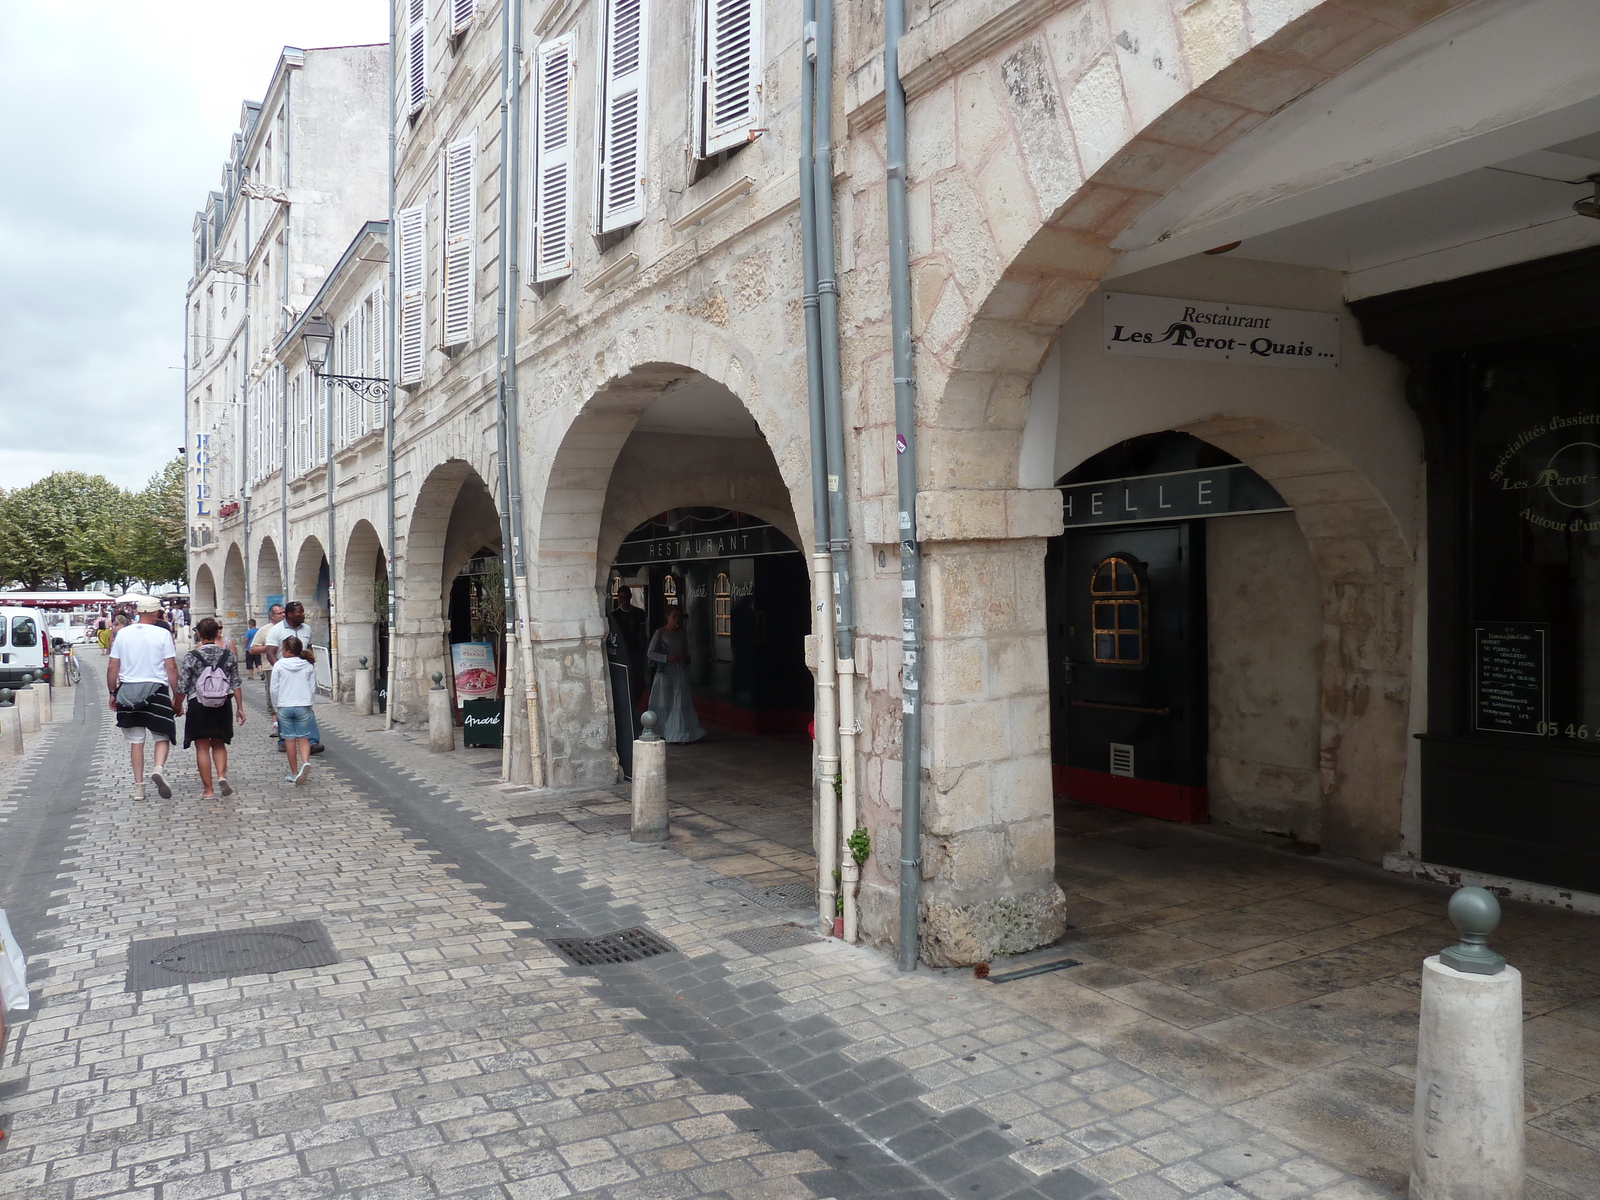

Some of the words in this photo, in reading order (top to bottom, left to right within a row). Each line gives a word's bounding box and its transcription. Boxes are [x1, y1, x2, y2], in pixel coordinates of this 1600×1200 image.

[1181, 307, 1271, 329] Restaurant
[1112, 326, 1152, 343] Les
[1489, 425, 1546, 482] Spécialités
[1501, 478, 1528, 490] Les
[1518, 507, 1567, 531] Autour
[649, 535, 748, 556] RESTAURANT
[731, 582, 754, 601] André
[465, 713, 500, 727] André
[1537, 721, 1558, 736] 05
[1565, 723, 1588, 739] 46
